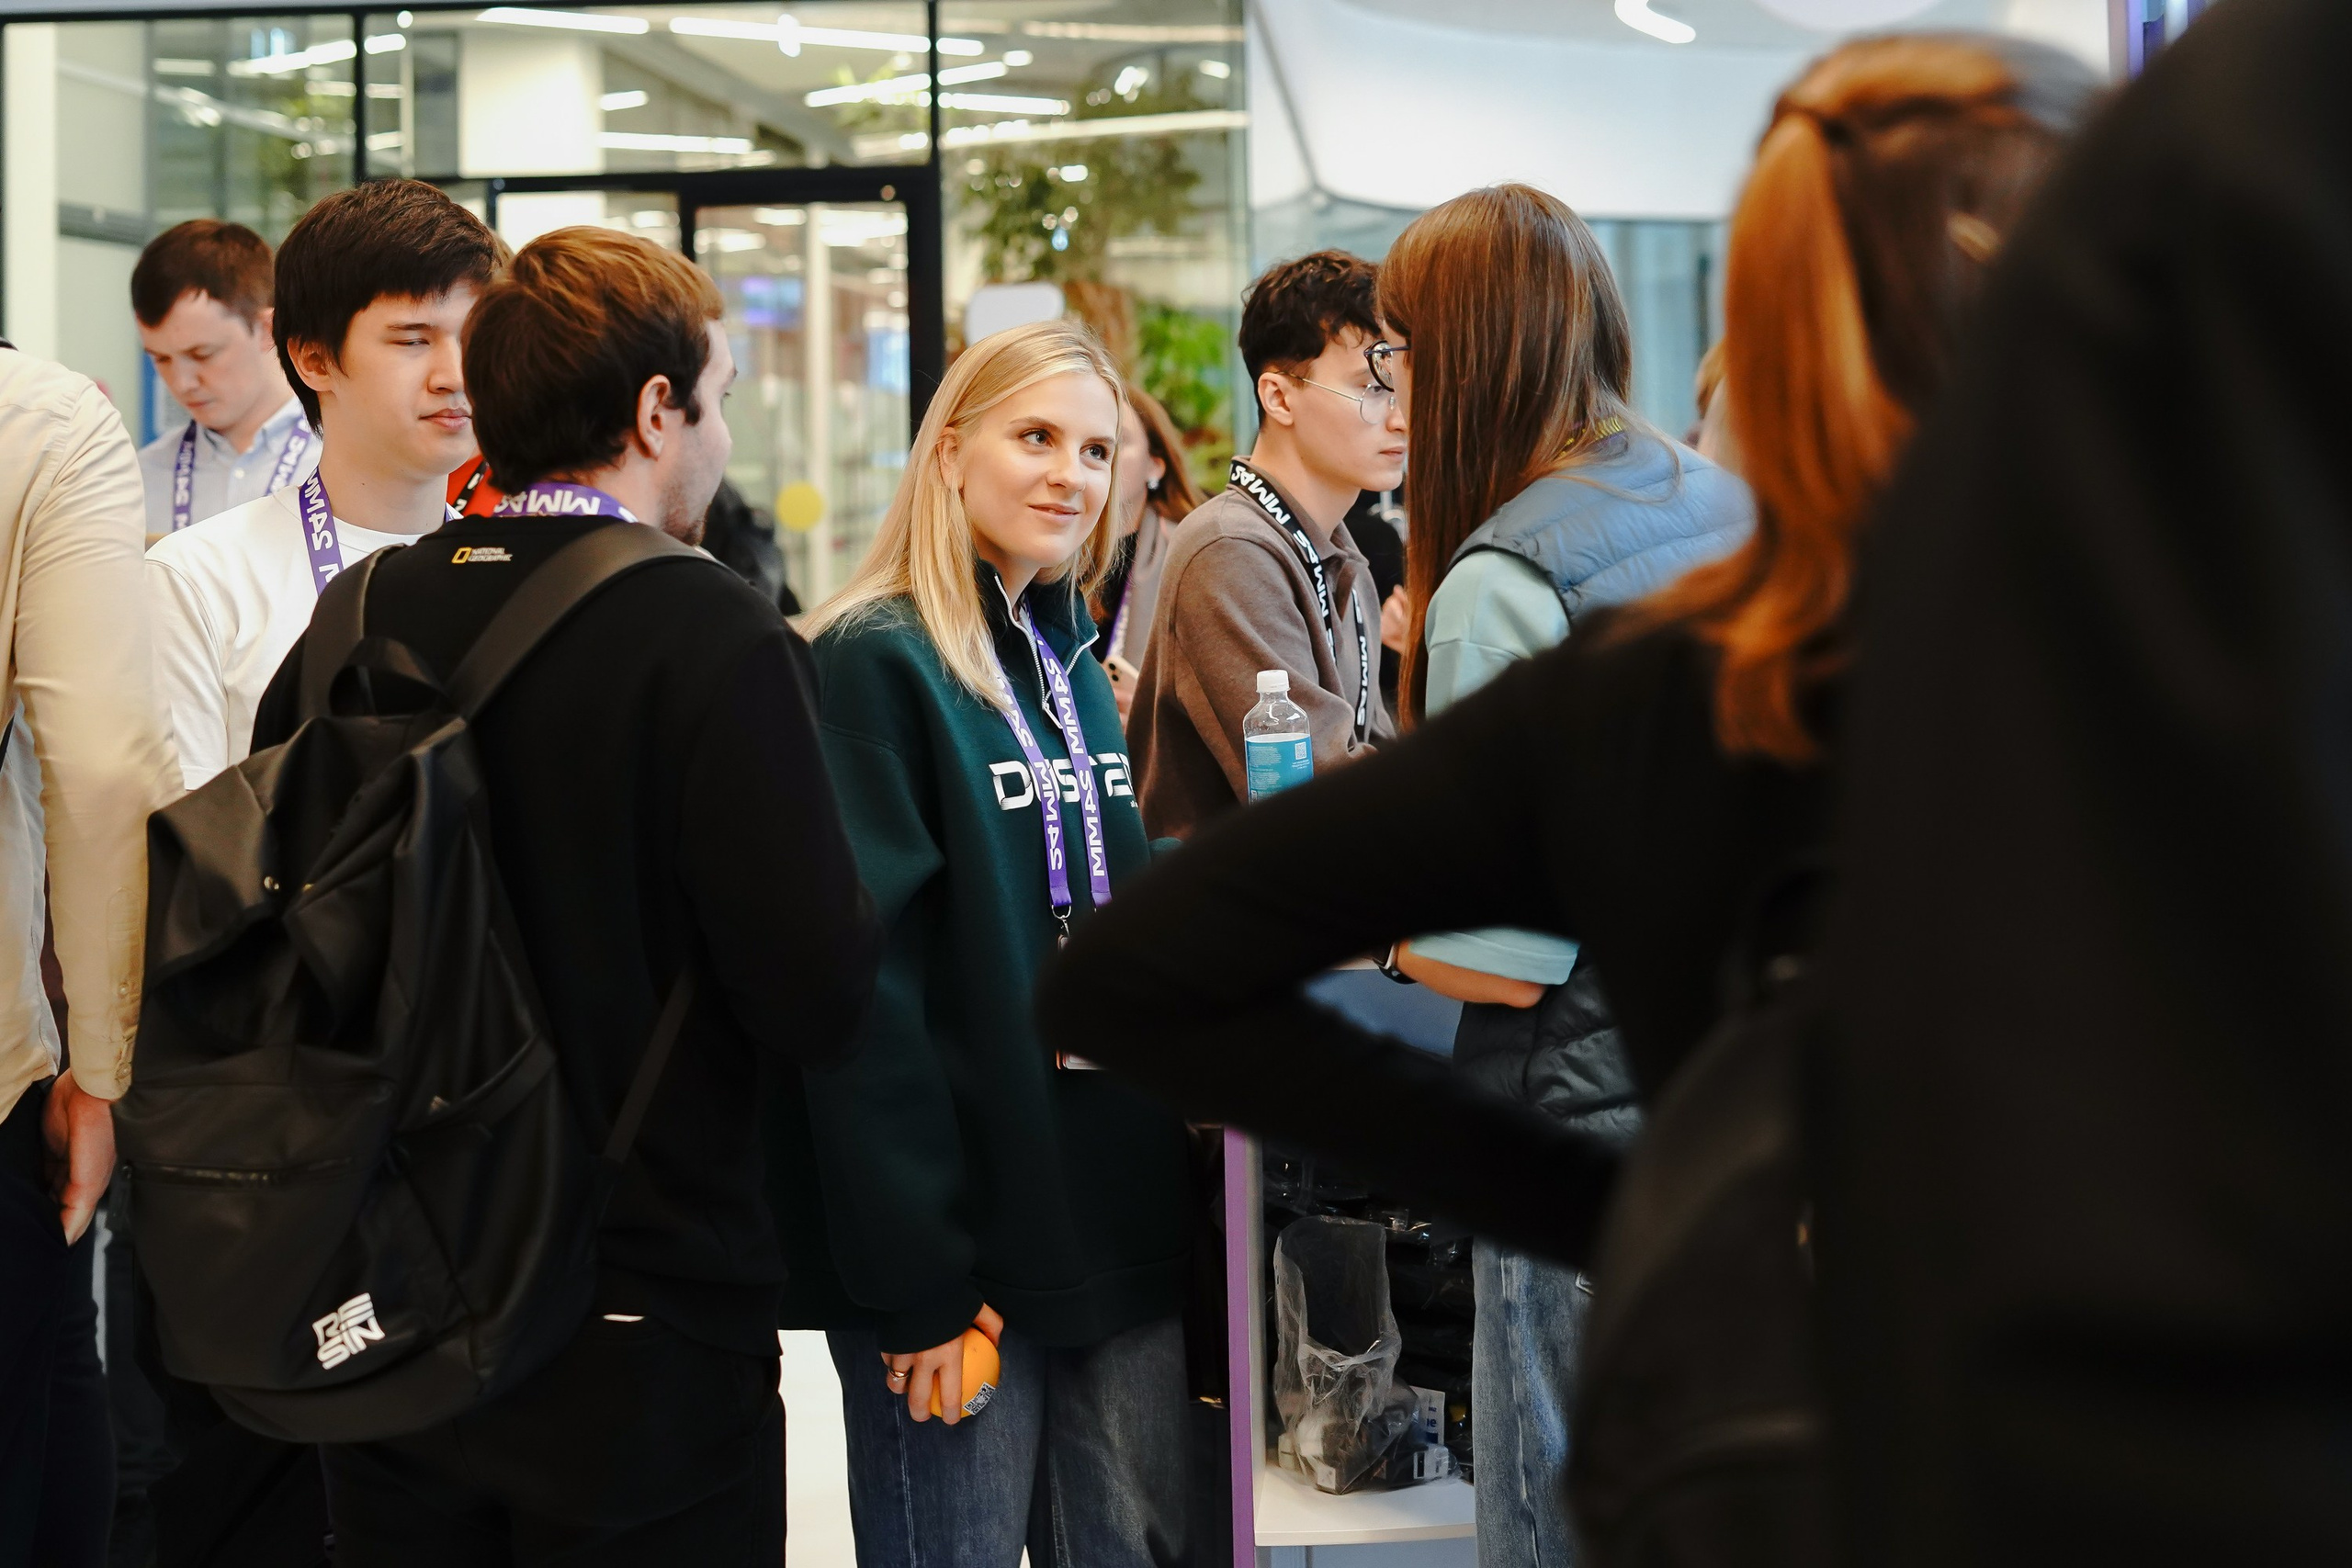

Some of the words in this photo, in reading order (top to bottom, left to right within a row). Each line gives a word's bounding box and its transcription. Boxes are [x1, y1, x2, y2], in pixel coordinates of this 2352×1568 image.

[1231, 465, 1291, 525] MMAS
[468, 554, 514, 562] GEOGRAPHIC
[1046, 658, 1084, 754] MMAS
[1035, 761, 1063, 871] MMAS
[1079, 770, 1105, 876] MMAS
